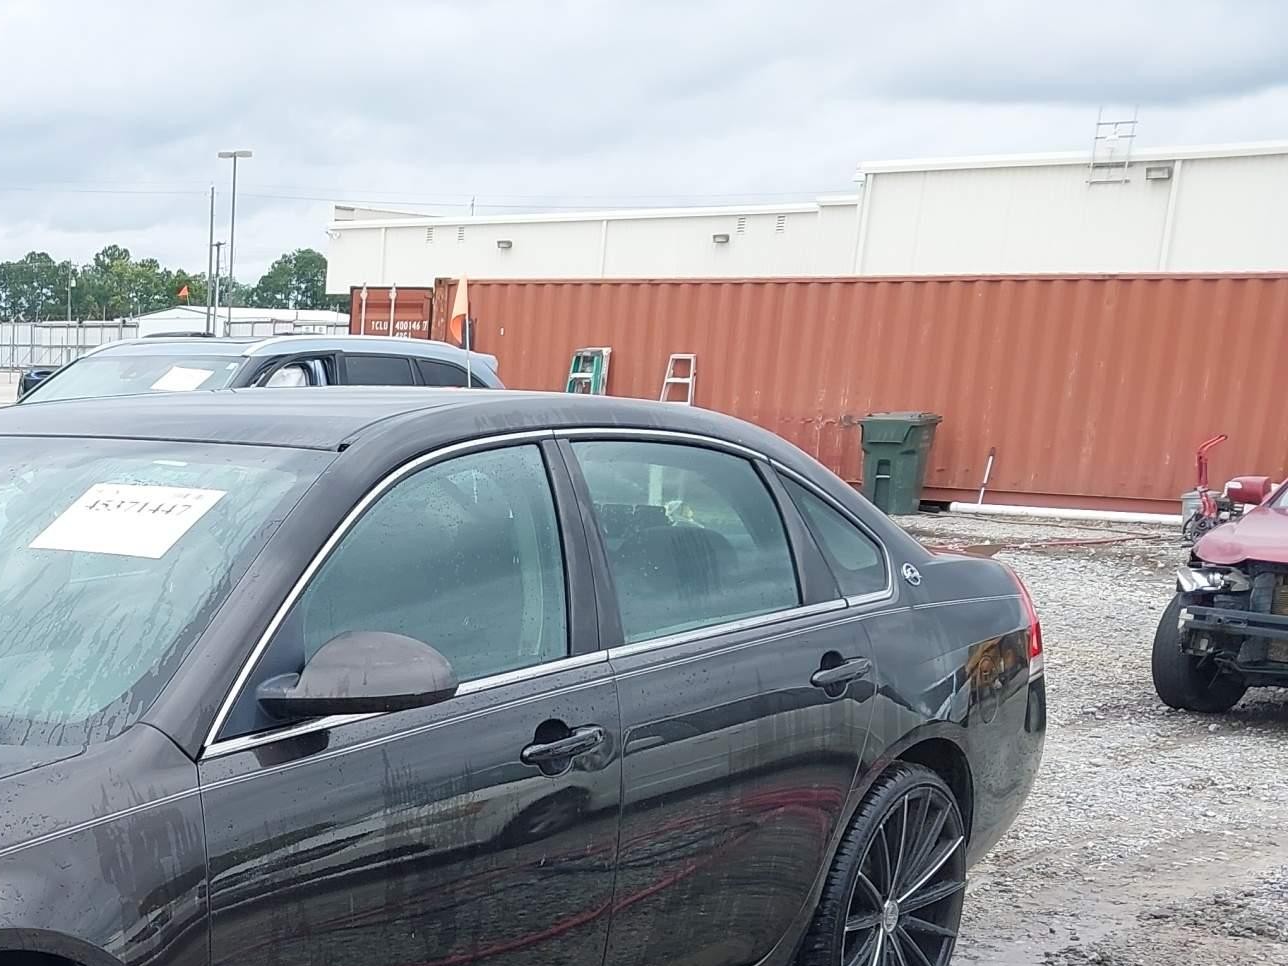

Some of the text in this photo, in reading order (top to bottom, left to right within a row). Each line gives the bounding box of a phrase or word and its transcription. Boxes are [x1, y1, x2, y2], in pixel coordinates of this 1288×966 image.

[371, 320, 389, 331] TCLU
[395, 320, 421, 331] 400146
[85, 499, 193, 516] 45371447
